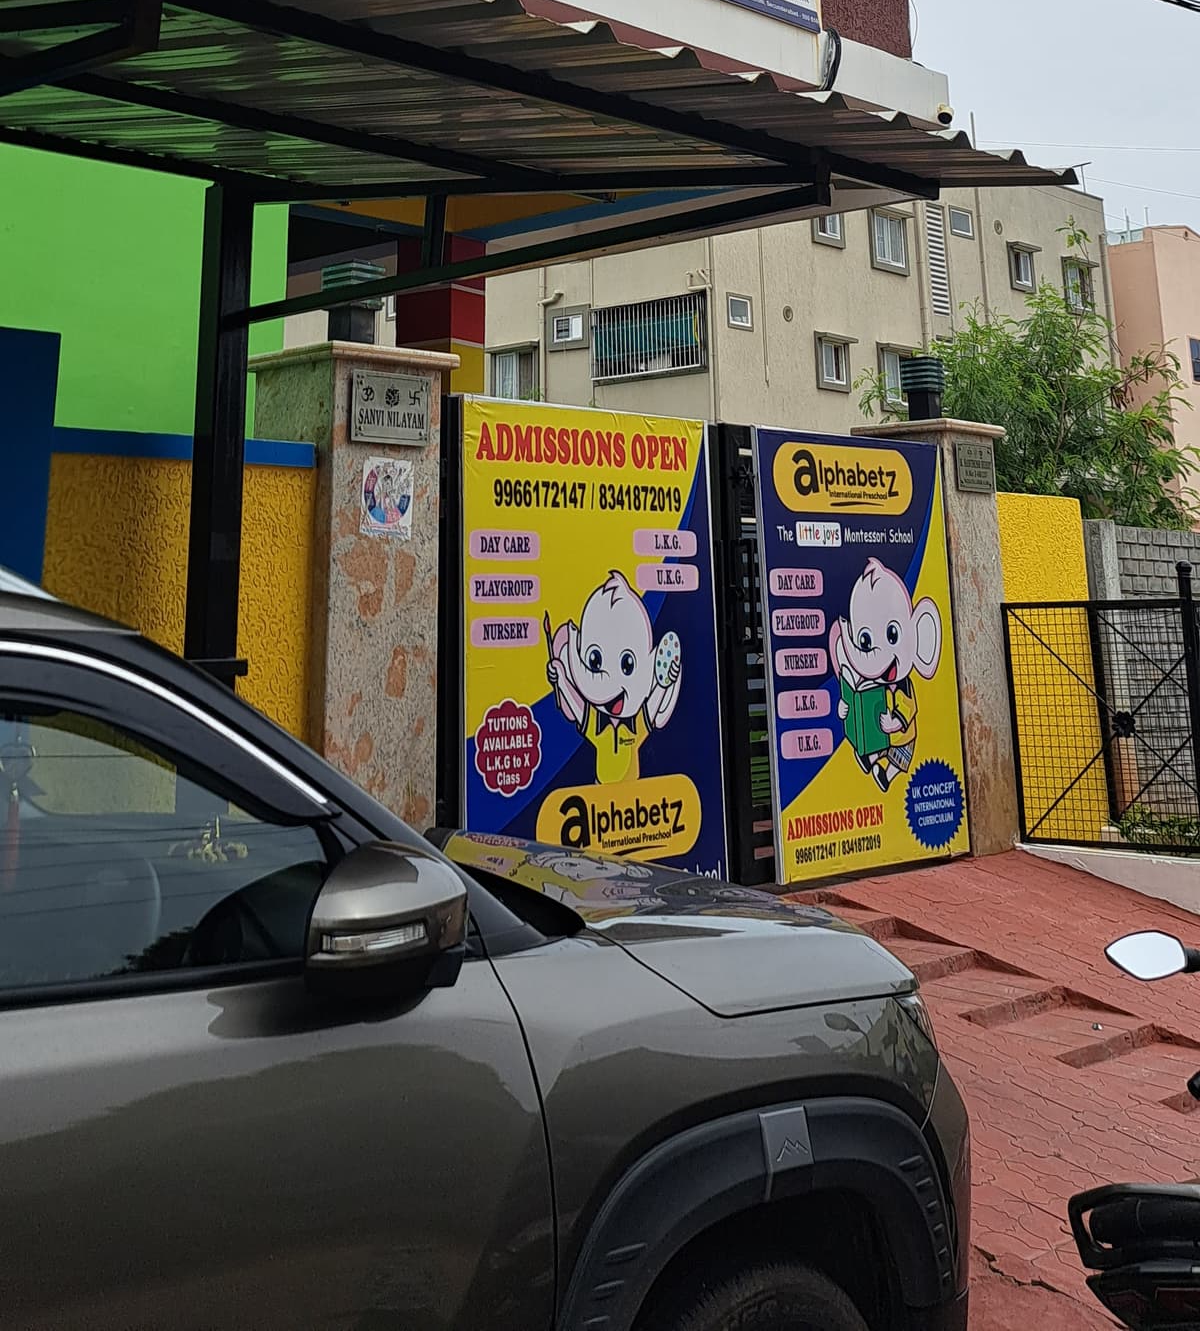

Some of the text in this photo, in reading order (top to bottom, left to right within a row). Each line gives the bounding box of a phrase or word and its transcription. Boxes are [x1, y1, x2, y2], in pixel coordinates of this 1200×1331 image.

[358, 408, 425, 430] SANVI NILAYAM
[476, 421, 687, 472] ADMISSIONS OPEN
[792, 449, 899, 497] alphabetz
[494, 479, 586, 509] 9966172147
[599, 483, 681, 512] 8341872019
[829, 490, 887, 500] International Preschool
[655, 534, 681, 550] L.K.G.
[776, 523, 914, 545] The little joys Montessori School
[480, 536, 530, 554] DAY CARE
[656, 569, 684, 585] U.K.G.
[778, 574, 816, 590] DAY CARE
[475, 580, 533, 597] PLAYGROUP
[483, 622, 529, 641] NURSERY
[776, 614, 820, 631] PLAYGROUP
[784, 653, 819, 671] NURSERY
[795, 694, 818, 712] L.K.G.
[487, 715, 528, 732] TUTIONS
[483, 733, 533, 753] AVAILABLE
[797, 735, 821, 752] U.K.G.
[486, 753, 530, 771] L.K.G to X
[496, 771, 520, 787] Class
[911, 781, 956, 799] UK CONCEPT
[914, 797, 956, 813] INTERNATIONAL
[559, 795, 685, 848] alphabetz
[787, 803, 884, 841] ADMISSIONS OPEN
[918, 812, 954, 827] CURRICULUM
[601, 828, 672, 849] International Preschool
[795, 842, 836, 865] 9966172147
[841, 834, 881, 856] 8341872019
